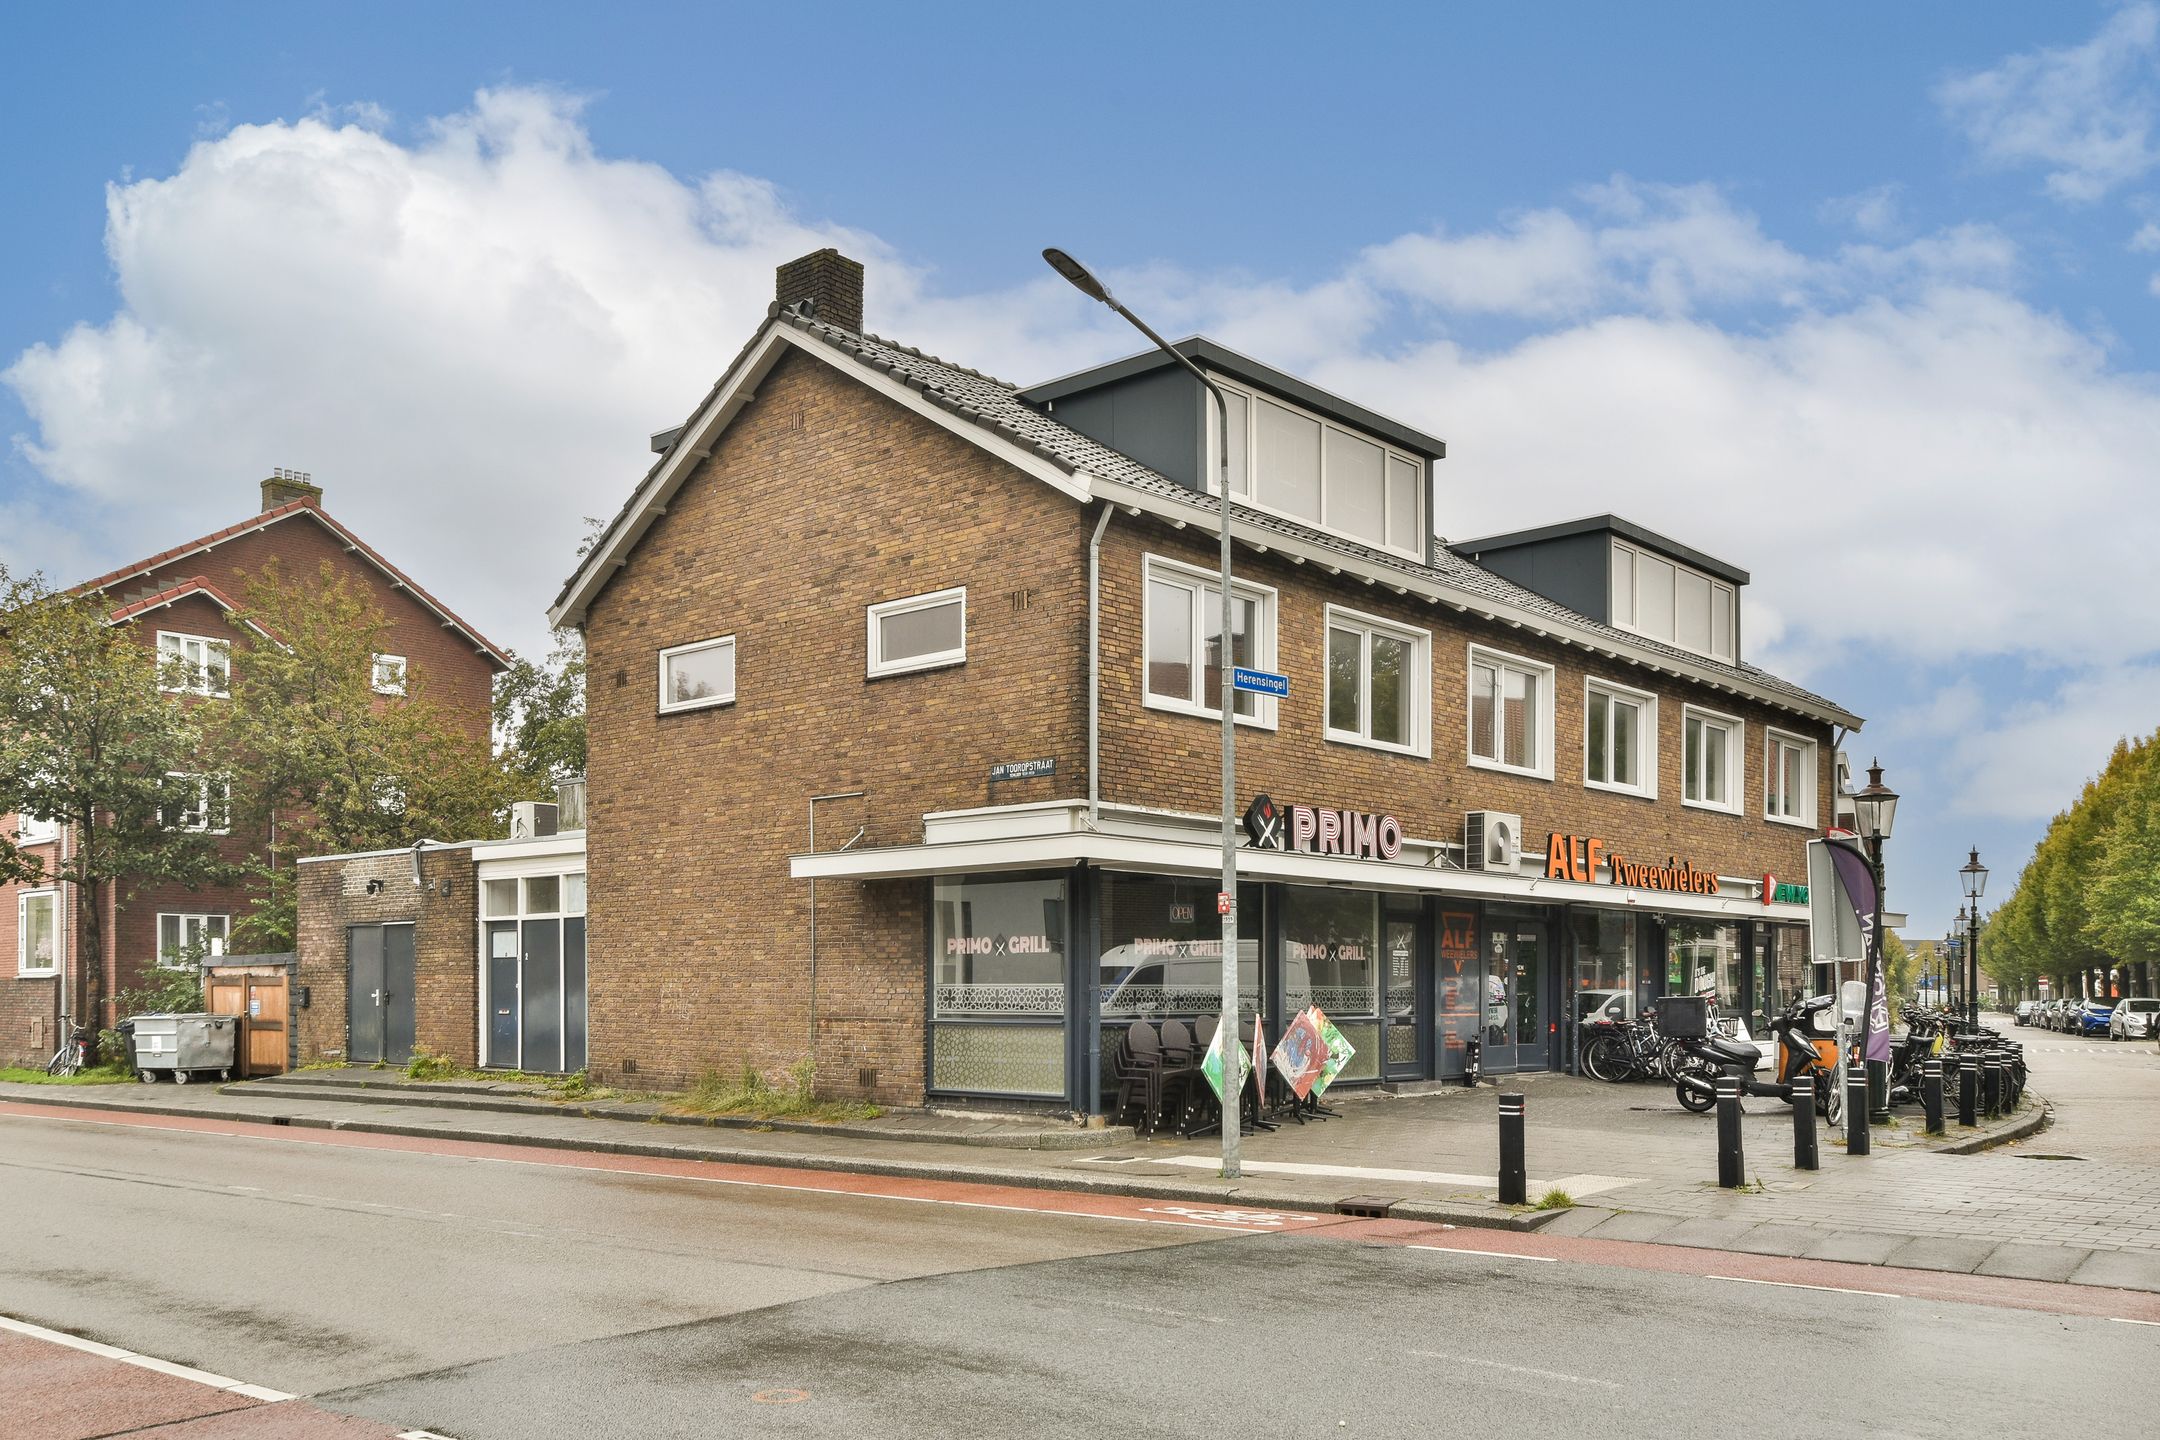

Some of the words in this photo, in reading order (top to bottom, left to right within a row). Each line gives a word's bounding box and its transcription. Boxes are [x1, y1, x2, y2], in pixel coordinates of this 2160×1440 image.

[1236, 671, 1286, 692] Herensingel
[991, 765, 1005, 776] JAN
[1006, 759, 1054, 773] TOOROPSTRAAT
[1284, 805, 1402, 861] PRIMO
[1545, 832, 1603, 885] ALF
[1607, 852, 1720, 895] Tweewielers
[1172, 906, 1193, 920] OPEN
[947, 937, 992, 955] PRIMO
[1008, 935, 1050, 954] GRILL
[1134, 937, 1176, 956] PRIMO
[1189, 939, 1223, 957] GRILL
[1441, 929, 1475, 949] ALF
[1292, 943, 1327, 960] PRIMO
[1338, 944, 1366, 961] GRILL
